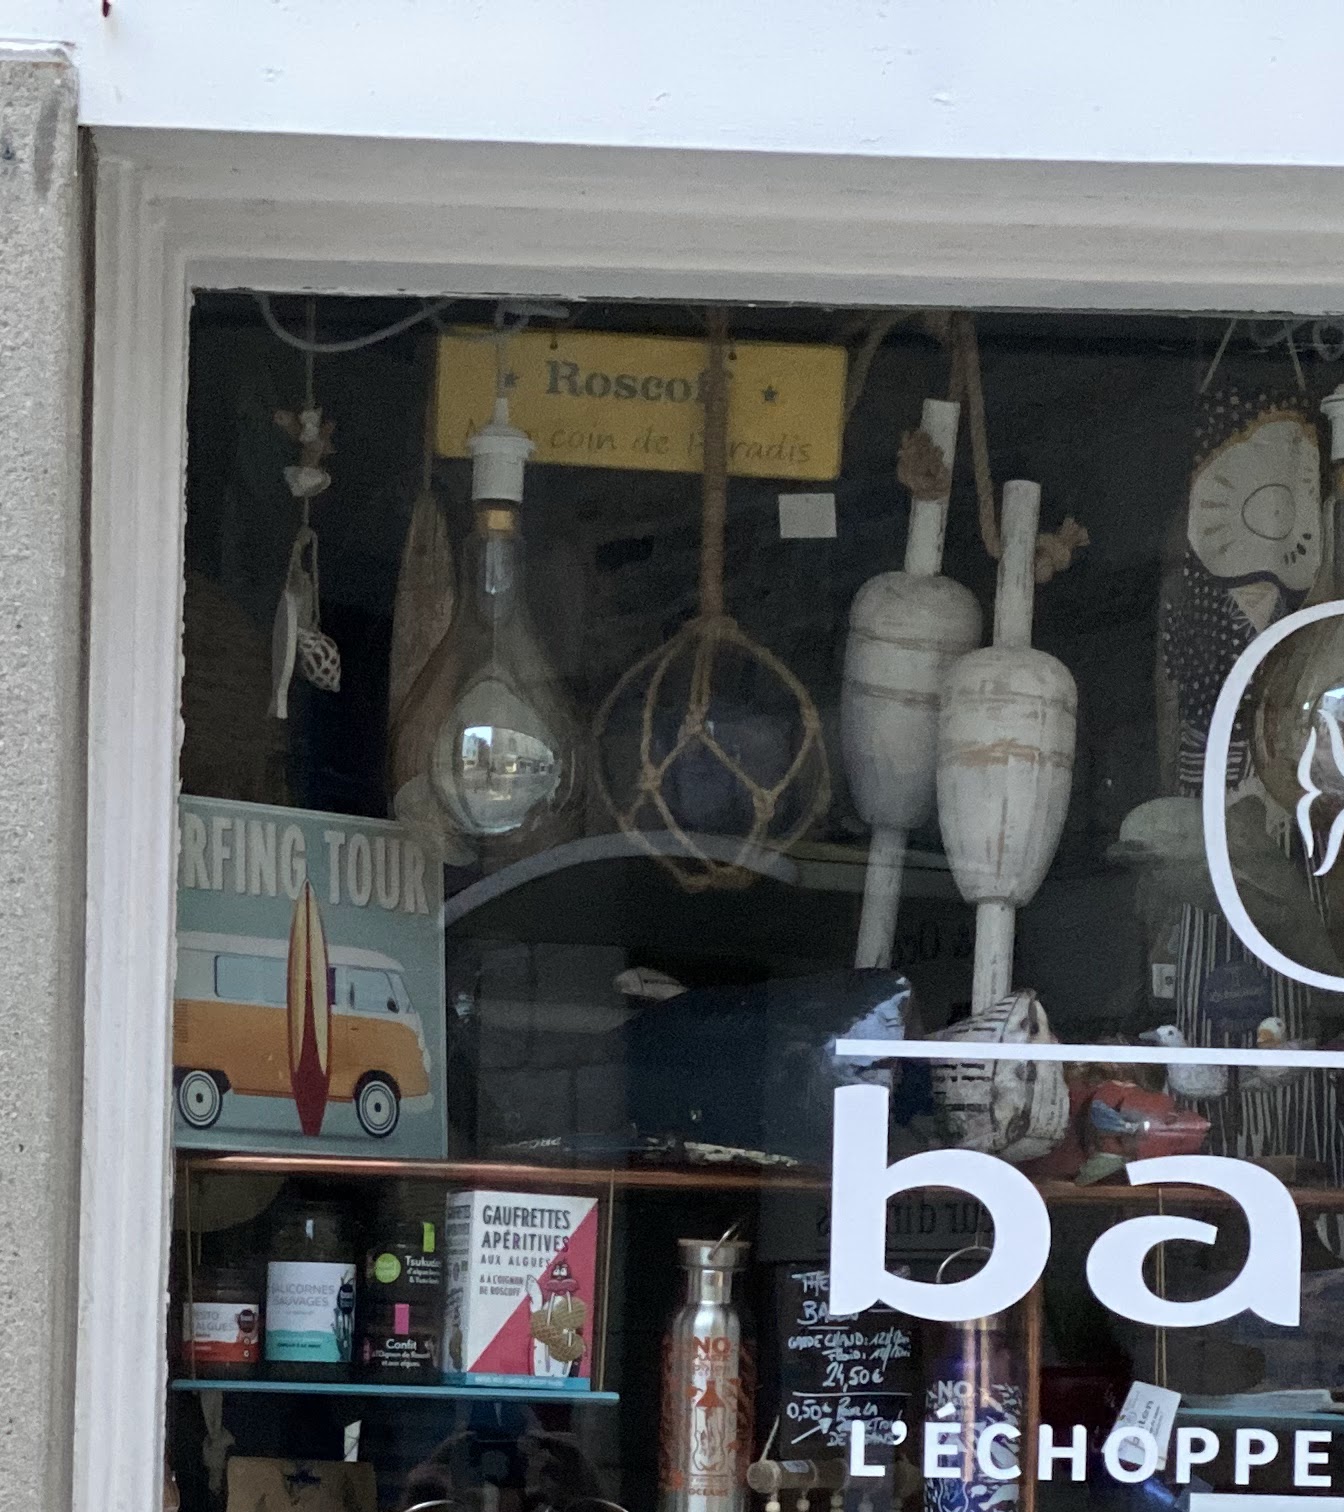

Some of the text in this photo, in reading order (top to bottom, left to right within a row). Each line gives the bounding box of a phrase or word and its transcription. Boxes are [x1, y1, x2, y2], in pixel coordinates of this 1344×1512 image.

[324, 831, 429, 915] TOUR
[481, 1229, 569, 1253] APÉRITIVES
[483, 1205, 571, 1230] GAUFRETTES
[851, 1402, 1332, 1490] L'ÉCHOPPE
